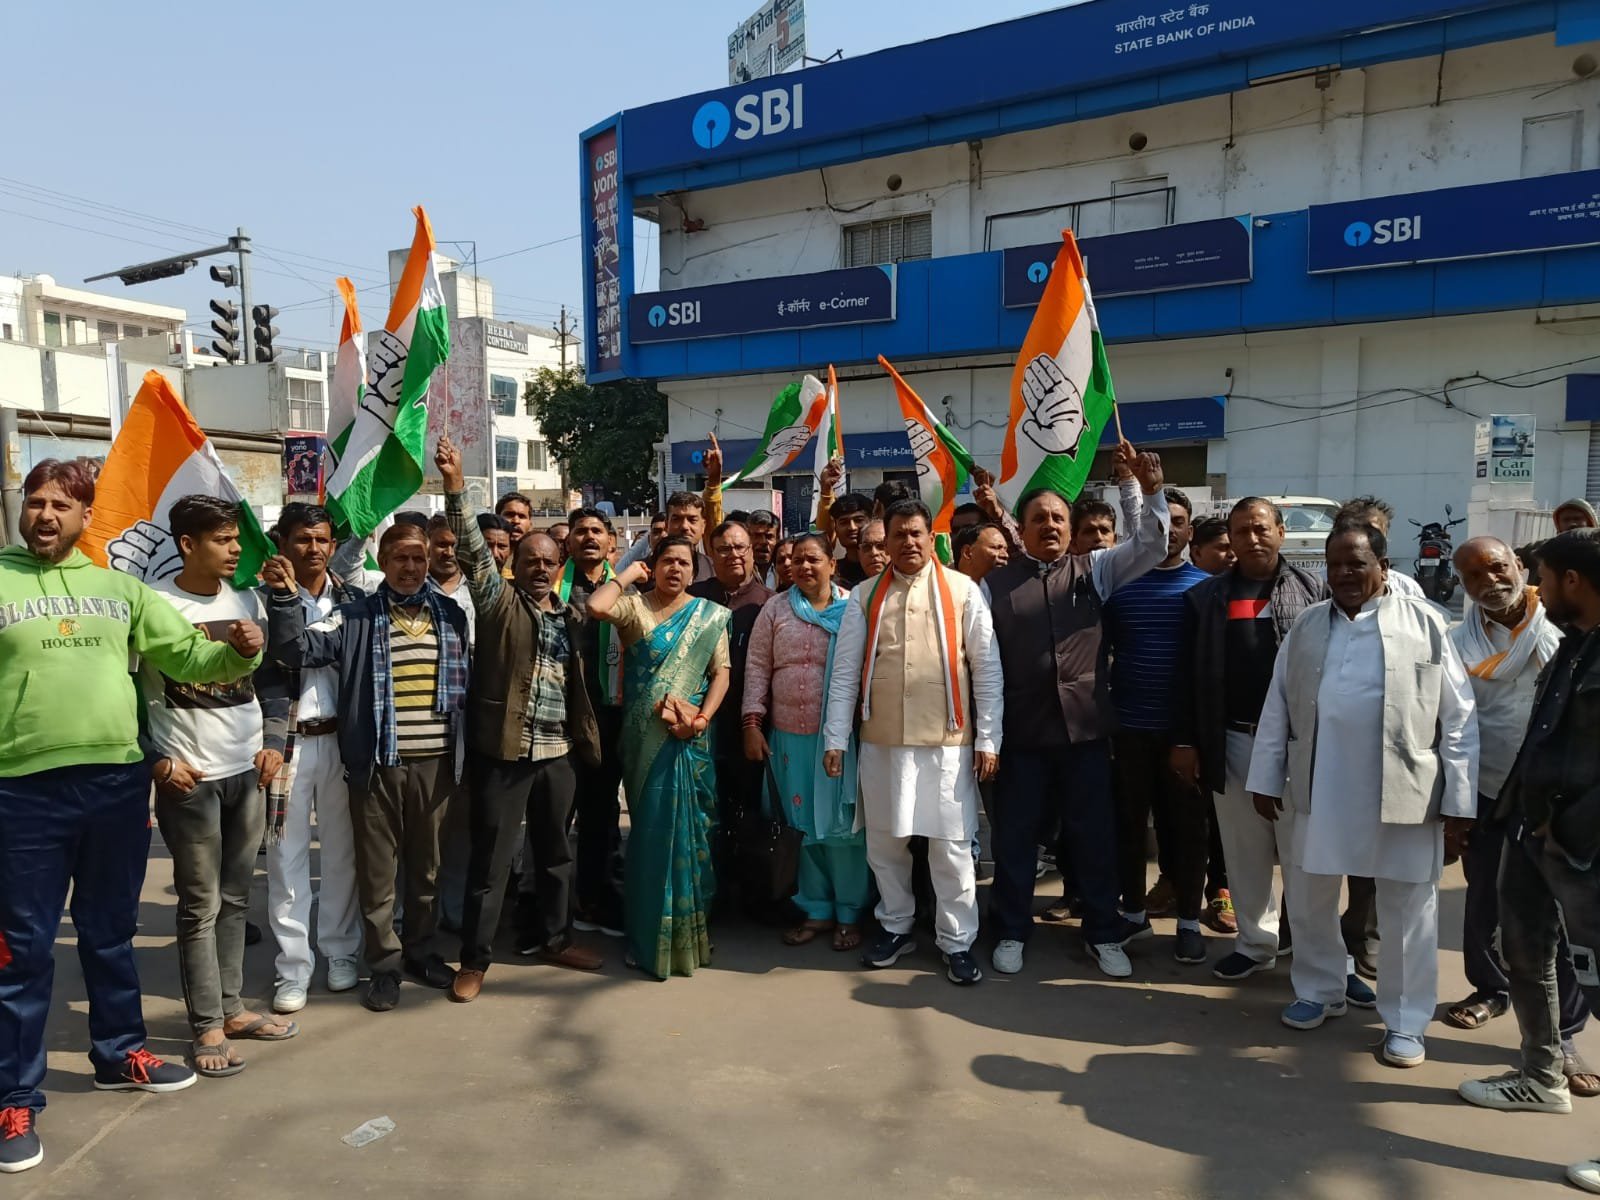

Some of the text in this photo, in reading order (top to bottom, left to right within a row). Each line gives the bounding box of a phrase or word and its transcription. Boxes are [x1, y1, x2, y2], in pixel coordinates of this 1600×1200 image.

[1115, 3, 1211, 34] भारतीय स्टेट बैंक
[1114, 15, 1256, 54] STATE BANK OF INDIA
[735, 83, 802, 140] SBI
[604, 148, 617, 168] SBI
[1373, 215, 1421, 244] SBI
[668, 300, 701, 326] SBI
[777, 297, 869, 316] ई-कॉर्नर e-Corner
[487, 324, 514, 339] HEERA
[1495, 467, 1530, 477] Loan
[1499, 458, 1527, 469] Car
[41, 637, 103, 649] HOCKEY
